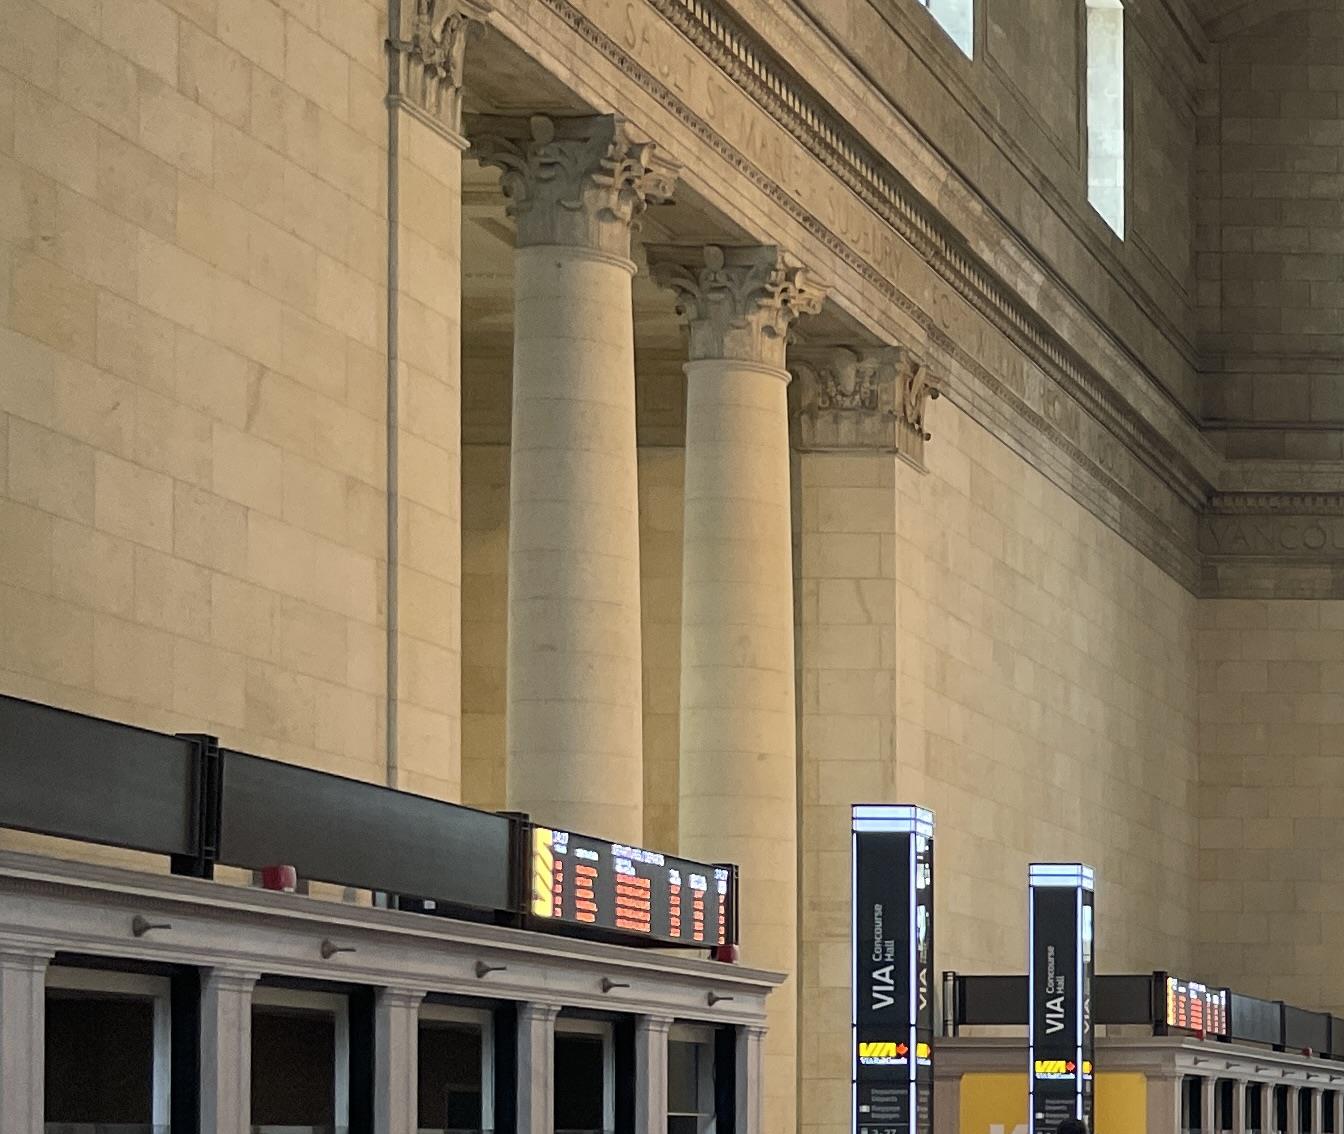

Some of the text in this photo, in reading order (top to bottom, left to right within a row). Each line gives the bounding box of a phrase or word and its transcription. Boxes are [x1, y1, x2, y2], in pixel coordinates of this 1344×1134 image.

[871, 903, 883, 962] Concourse
[884, 939, 895, 962] Hall
[1045, 945, 1055, 994] Concourse
[1055, 975, 1065, 994] Hall
[871, 964, 895, 1010] VIA
[1045, 996, 1065, 1035] VIA
[858, 1042, 897, 1057] VIA
[1034, 1060, 1067, 1073] VIA
